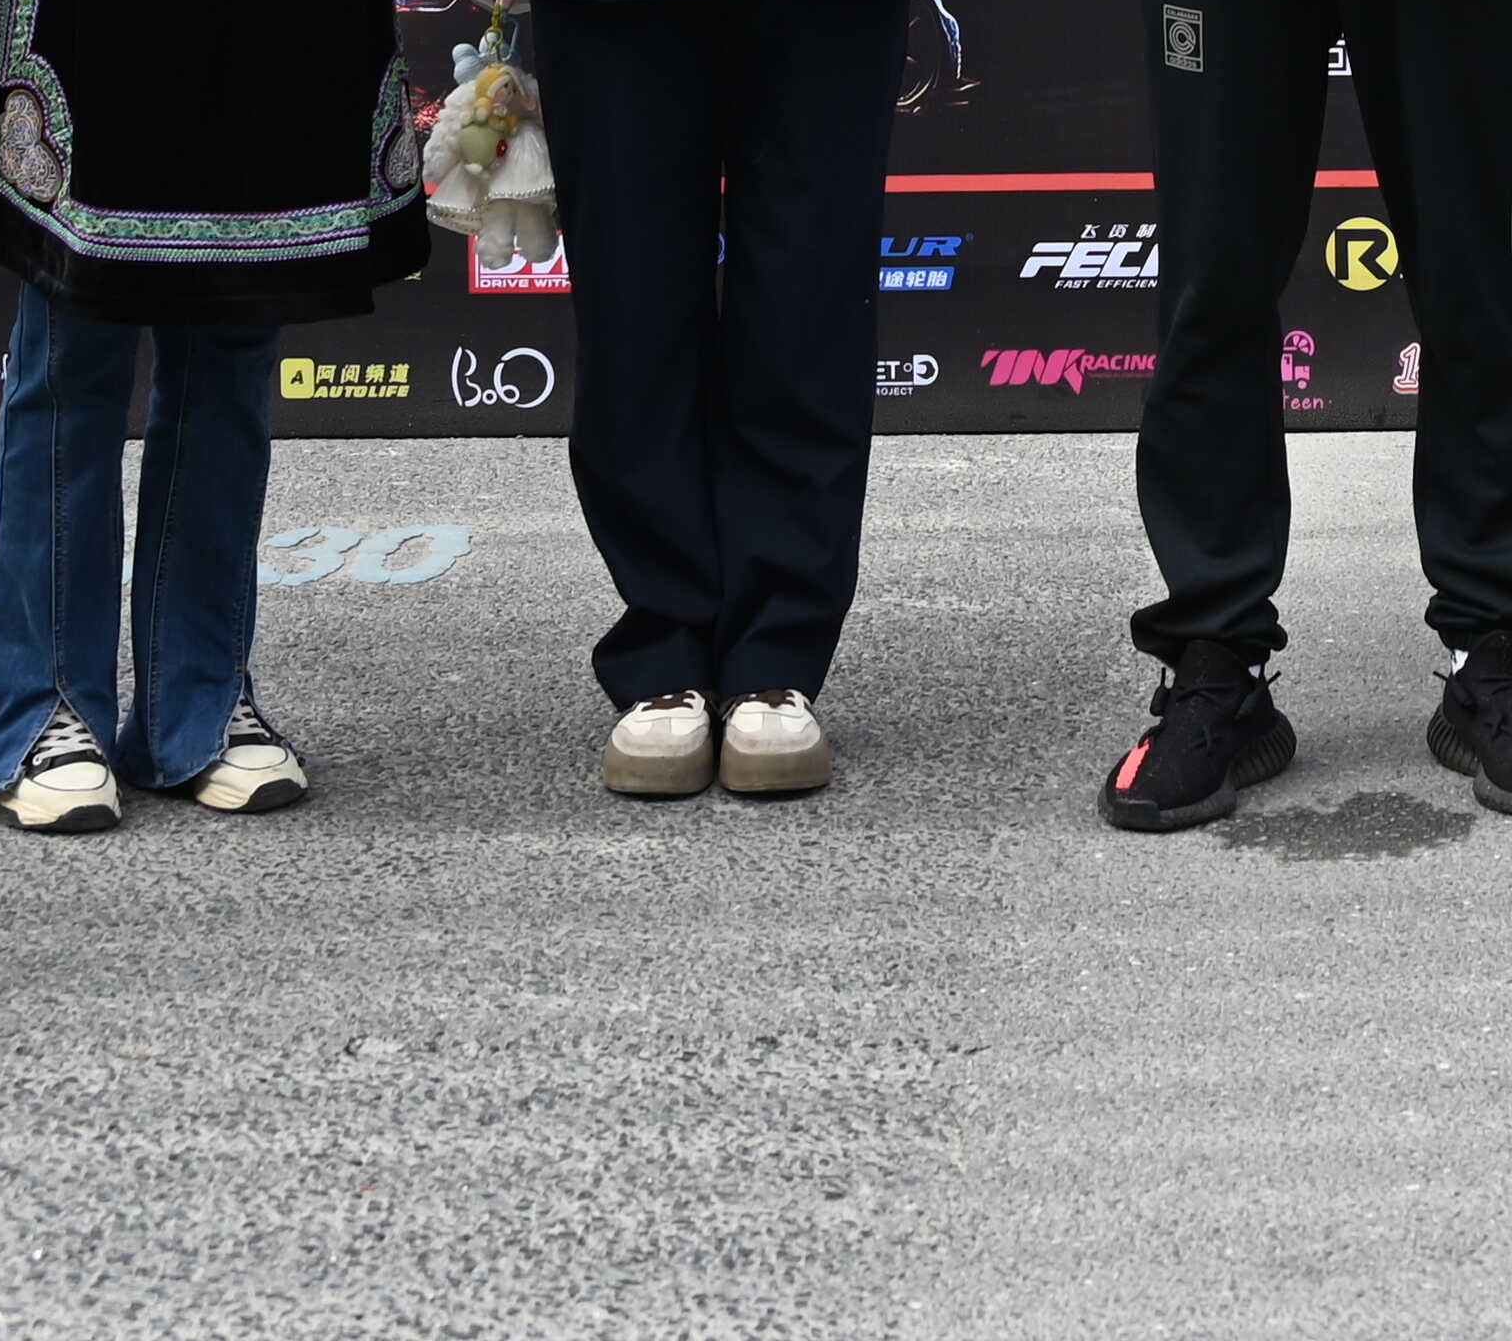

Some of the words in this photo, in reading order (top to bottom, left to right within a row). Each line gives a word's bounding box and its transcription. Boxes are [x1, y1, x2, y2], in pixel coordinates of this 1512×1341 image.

[480, 278, 529, 288] DRIVE
[879, 270, 949, 288] 途轮胎
[1054, 279, 1090, 289] FAST
[1096, 279, 1158, 289] EFFICIEN
[314, 385, 410, 398] AUTOLIFE
